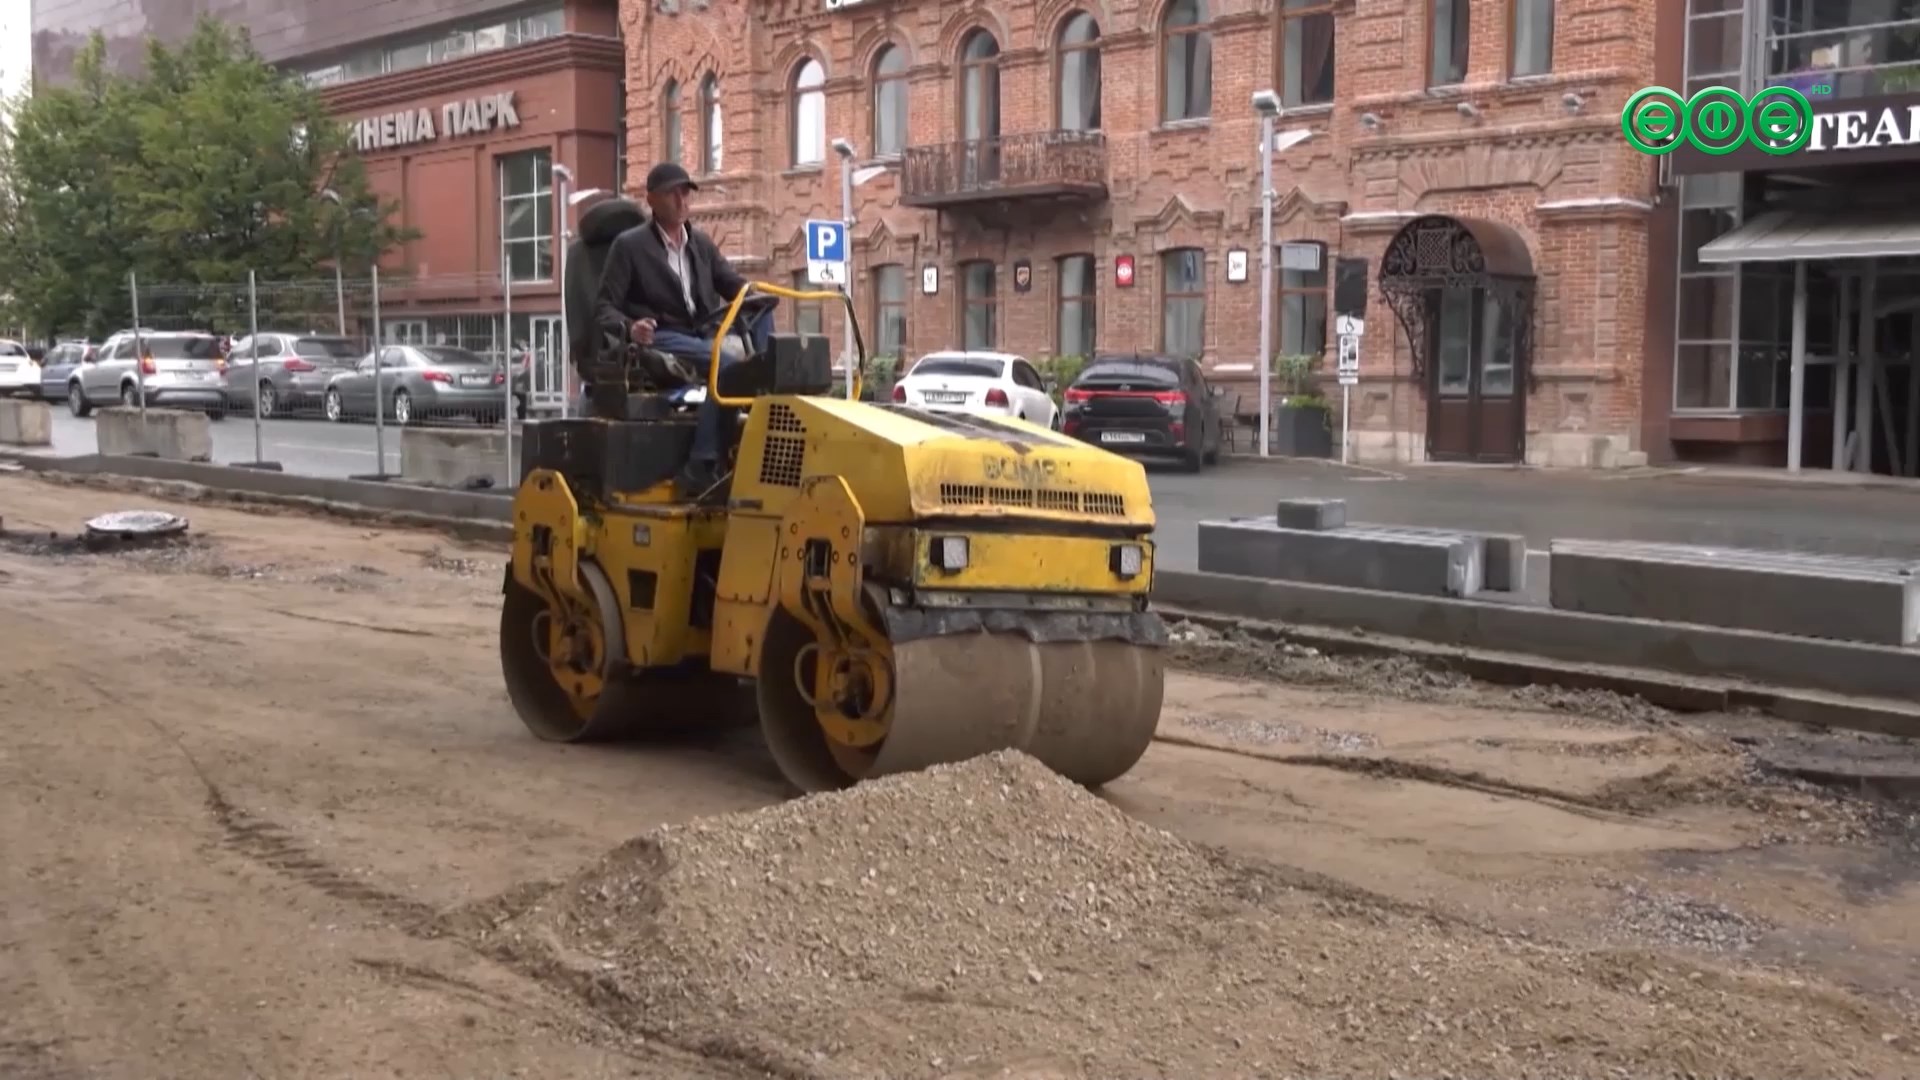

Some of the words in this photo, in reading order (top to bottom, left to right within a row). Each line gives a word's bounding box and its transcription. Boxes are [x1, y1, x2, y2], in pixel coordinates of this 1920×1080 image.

[347, 107, 436, 150] ИНЕМА
[442, 90, 520, 137] ПАРК
[1770, 104, 1920, 152] TEA
[818, 225, 837, 258] P
